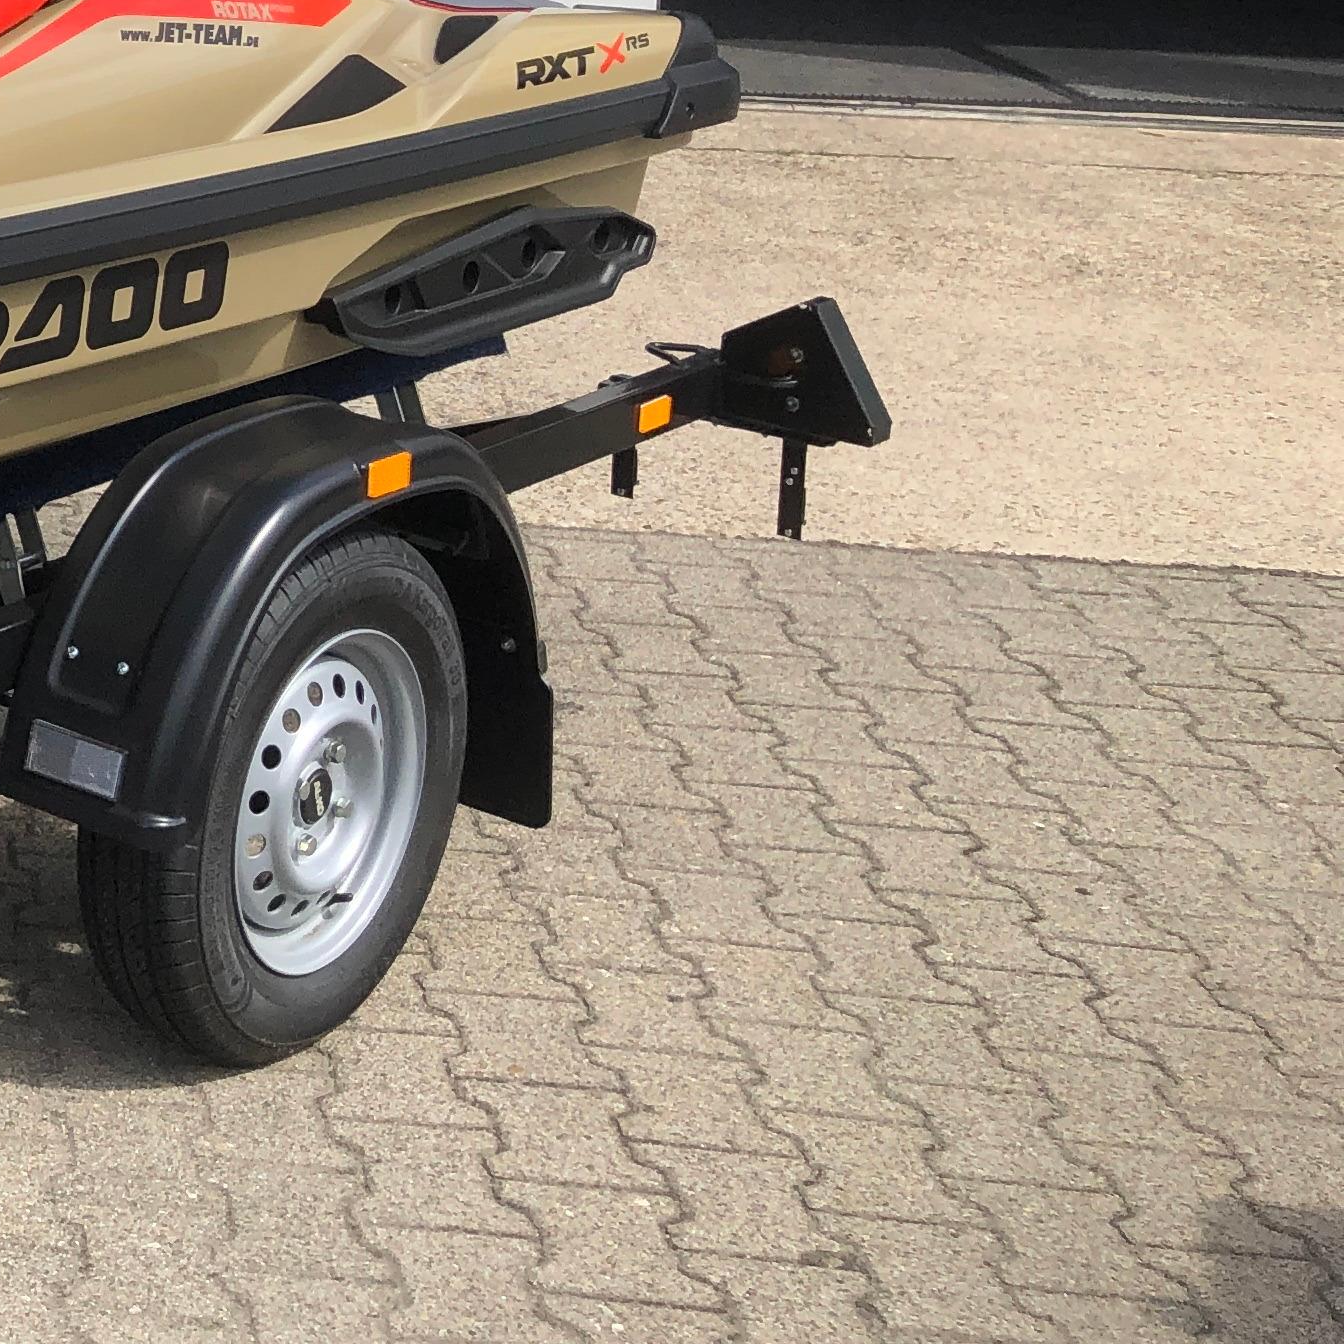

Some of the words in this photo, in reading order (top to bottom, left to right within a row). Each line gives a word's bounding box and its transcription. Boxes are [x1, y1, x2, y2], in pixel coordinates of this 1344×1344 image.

[211, 0, 274, 21] ROTAX
[516, 45, 595, 90] RXT
[625, 32, 650, 51] RS
